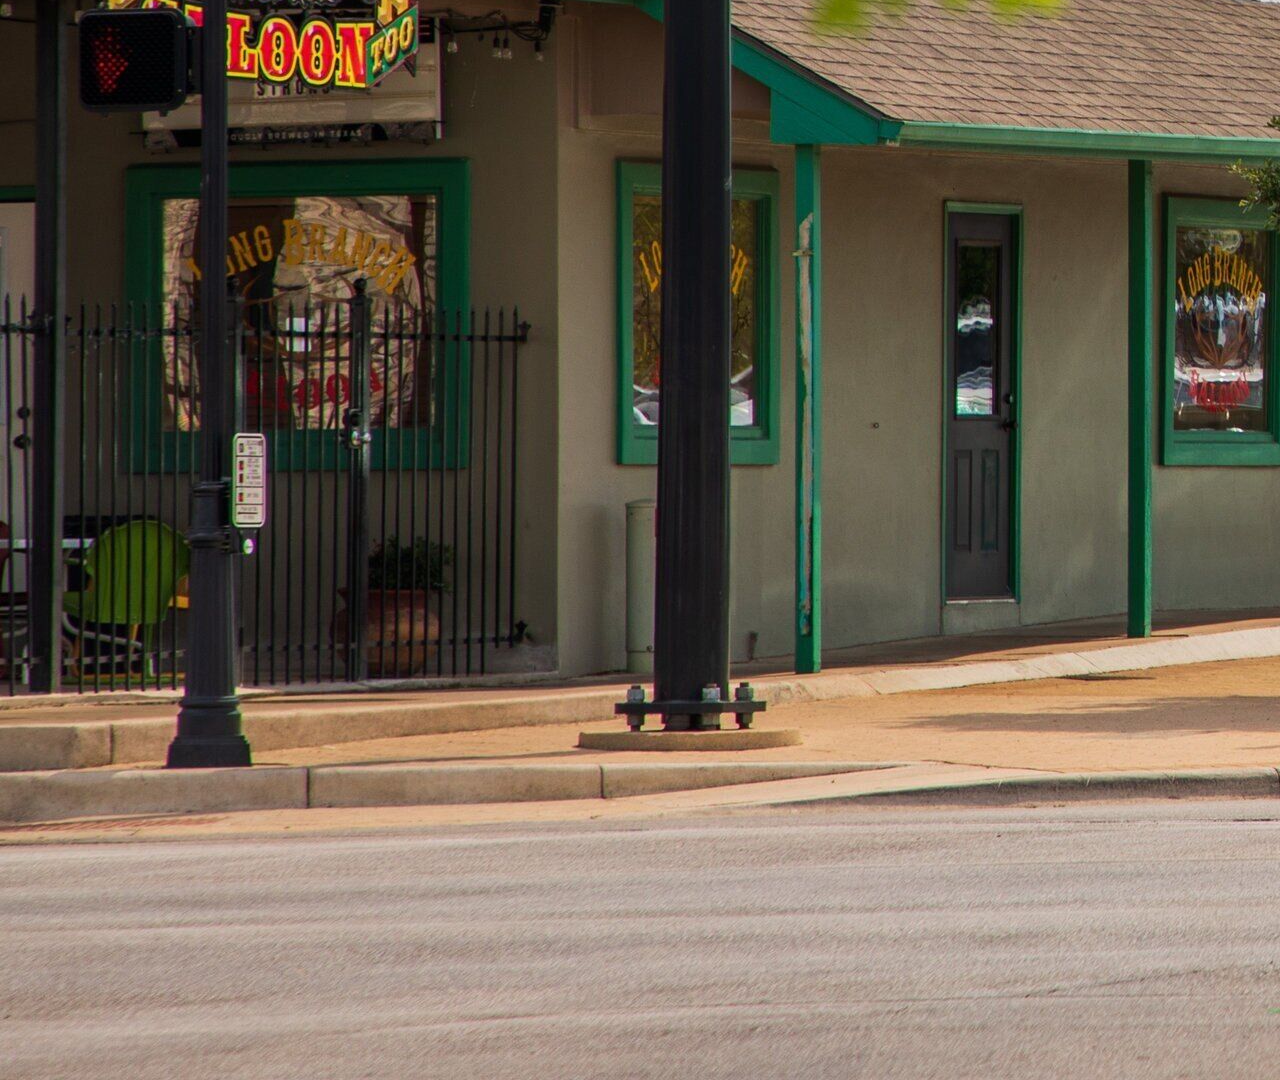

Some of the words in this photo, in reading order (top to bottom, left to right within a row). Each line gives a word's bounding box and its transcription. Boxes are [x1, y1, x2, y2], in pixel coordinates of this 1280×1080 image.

[370, 15, 415, 74] TOO
[283, 219, 416, 295] BRANCH
[1177, 251, 1211, 314] LONG
[1213, 244, 1263, 316] BRANCH
